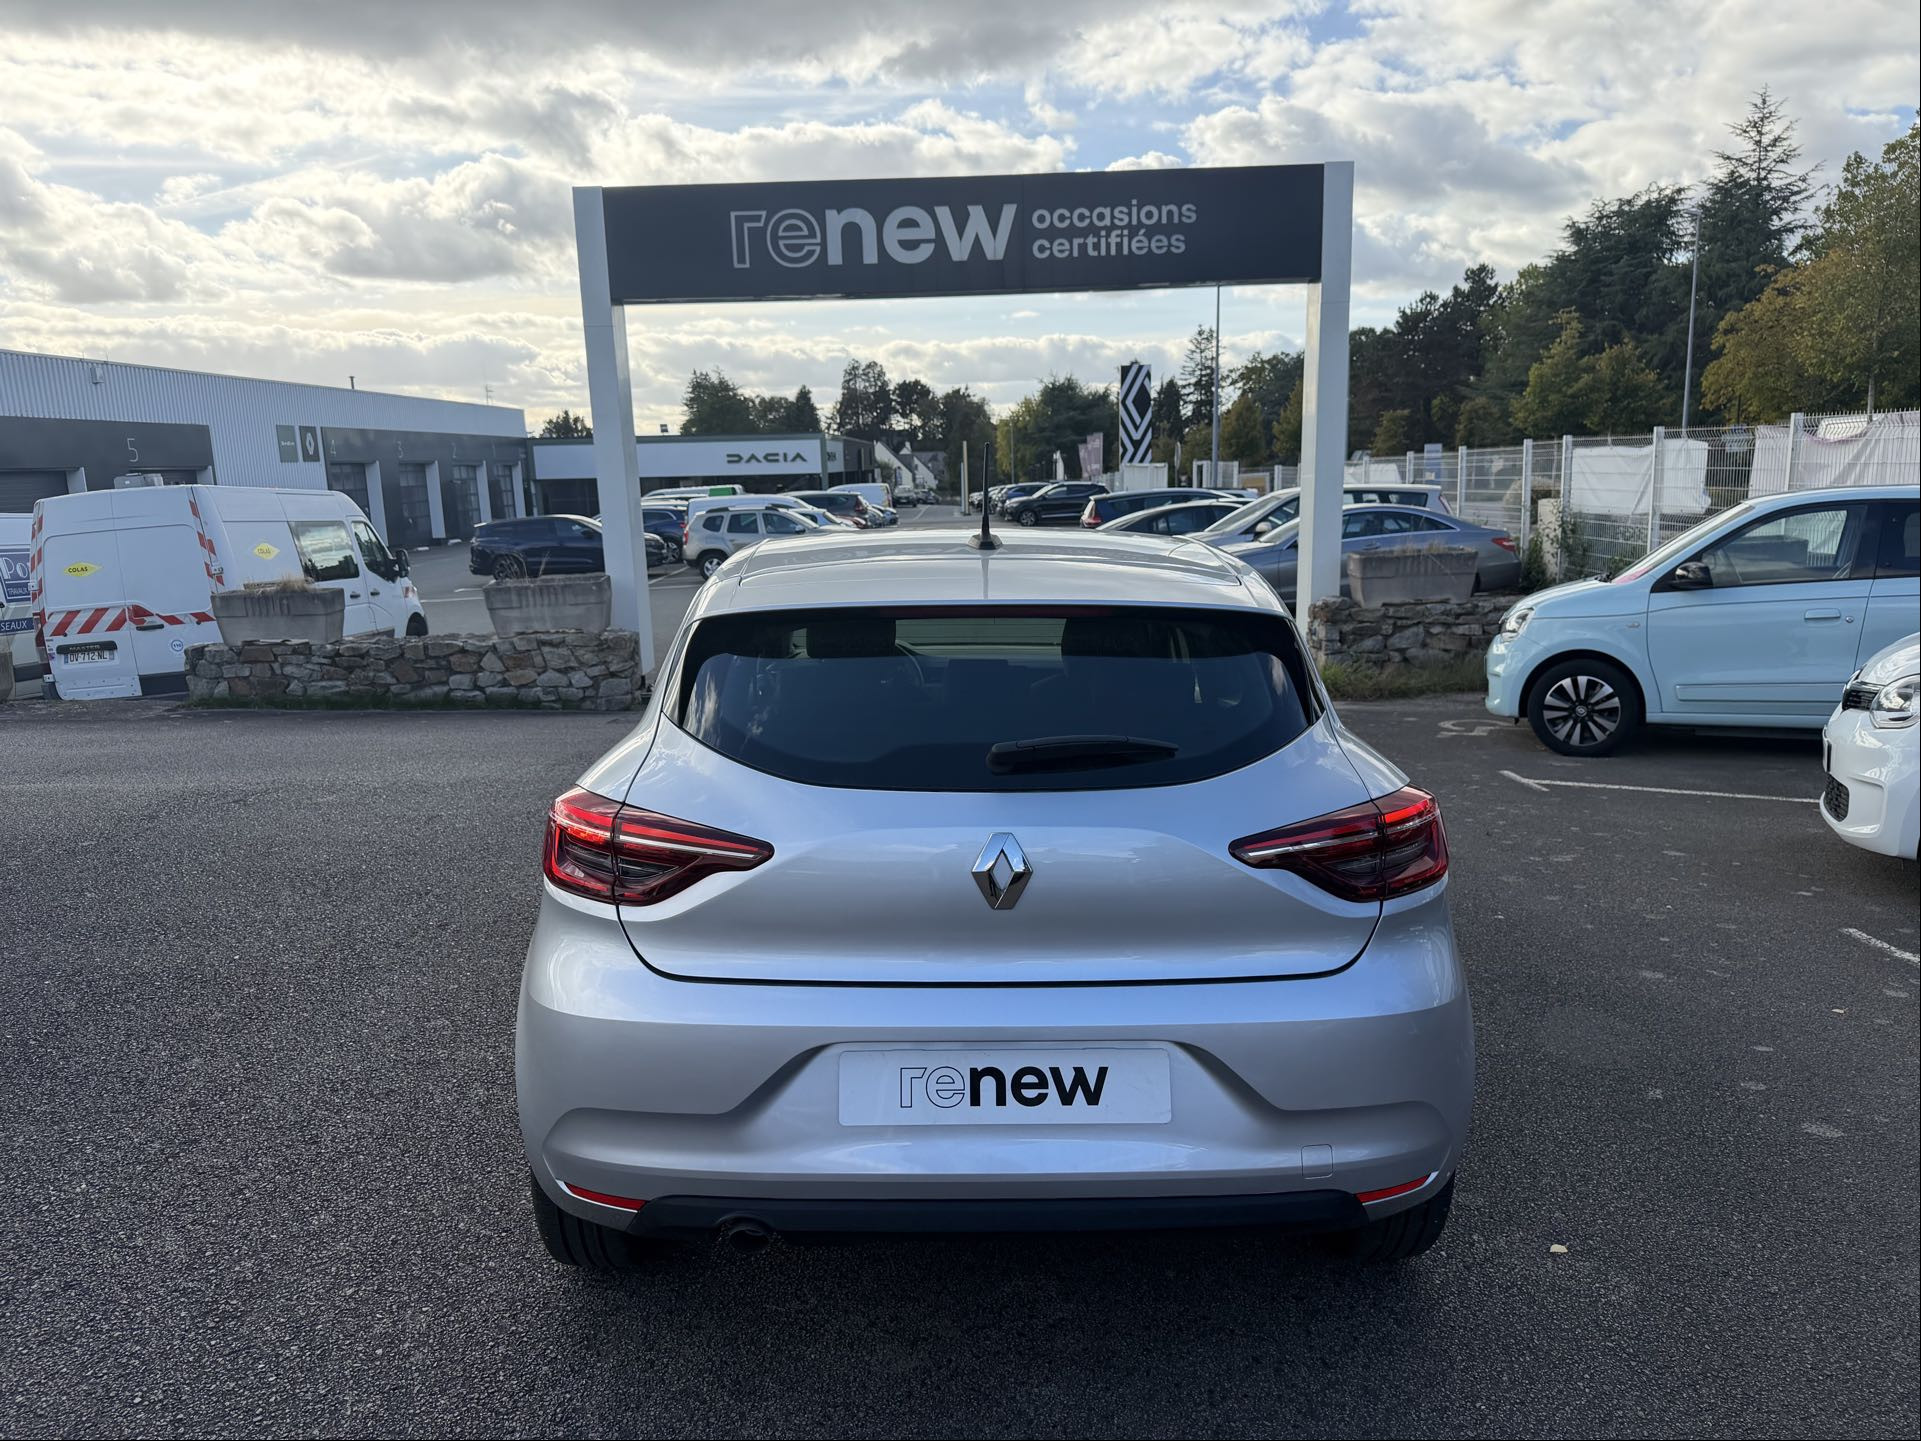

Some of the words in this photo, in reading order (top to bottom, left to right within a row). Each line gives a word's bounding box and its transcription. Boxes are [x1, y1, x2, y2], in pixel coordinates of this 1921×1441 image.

[1031, 199, 1198, 229] occasions
[730, 203, 1018, 268] renew
[1031, 228, 1186, 259] certifiées
[127, 437, 139, 462] 5
[330, 439, 337, 457] 4
[397, 440, 404, 458] 3
[451, 441, 457, 459] 2
[726, 452, 808, 464] DACIA
[0, 557, 30, 580] Po
[1, 620, 28, 631] SEAUX
[900, 1066, 1109, 1108] renew
